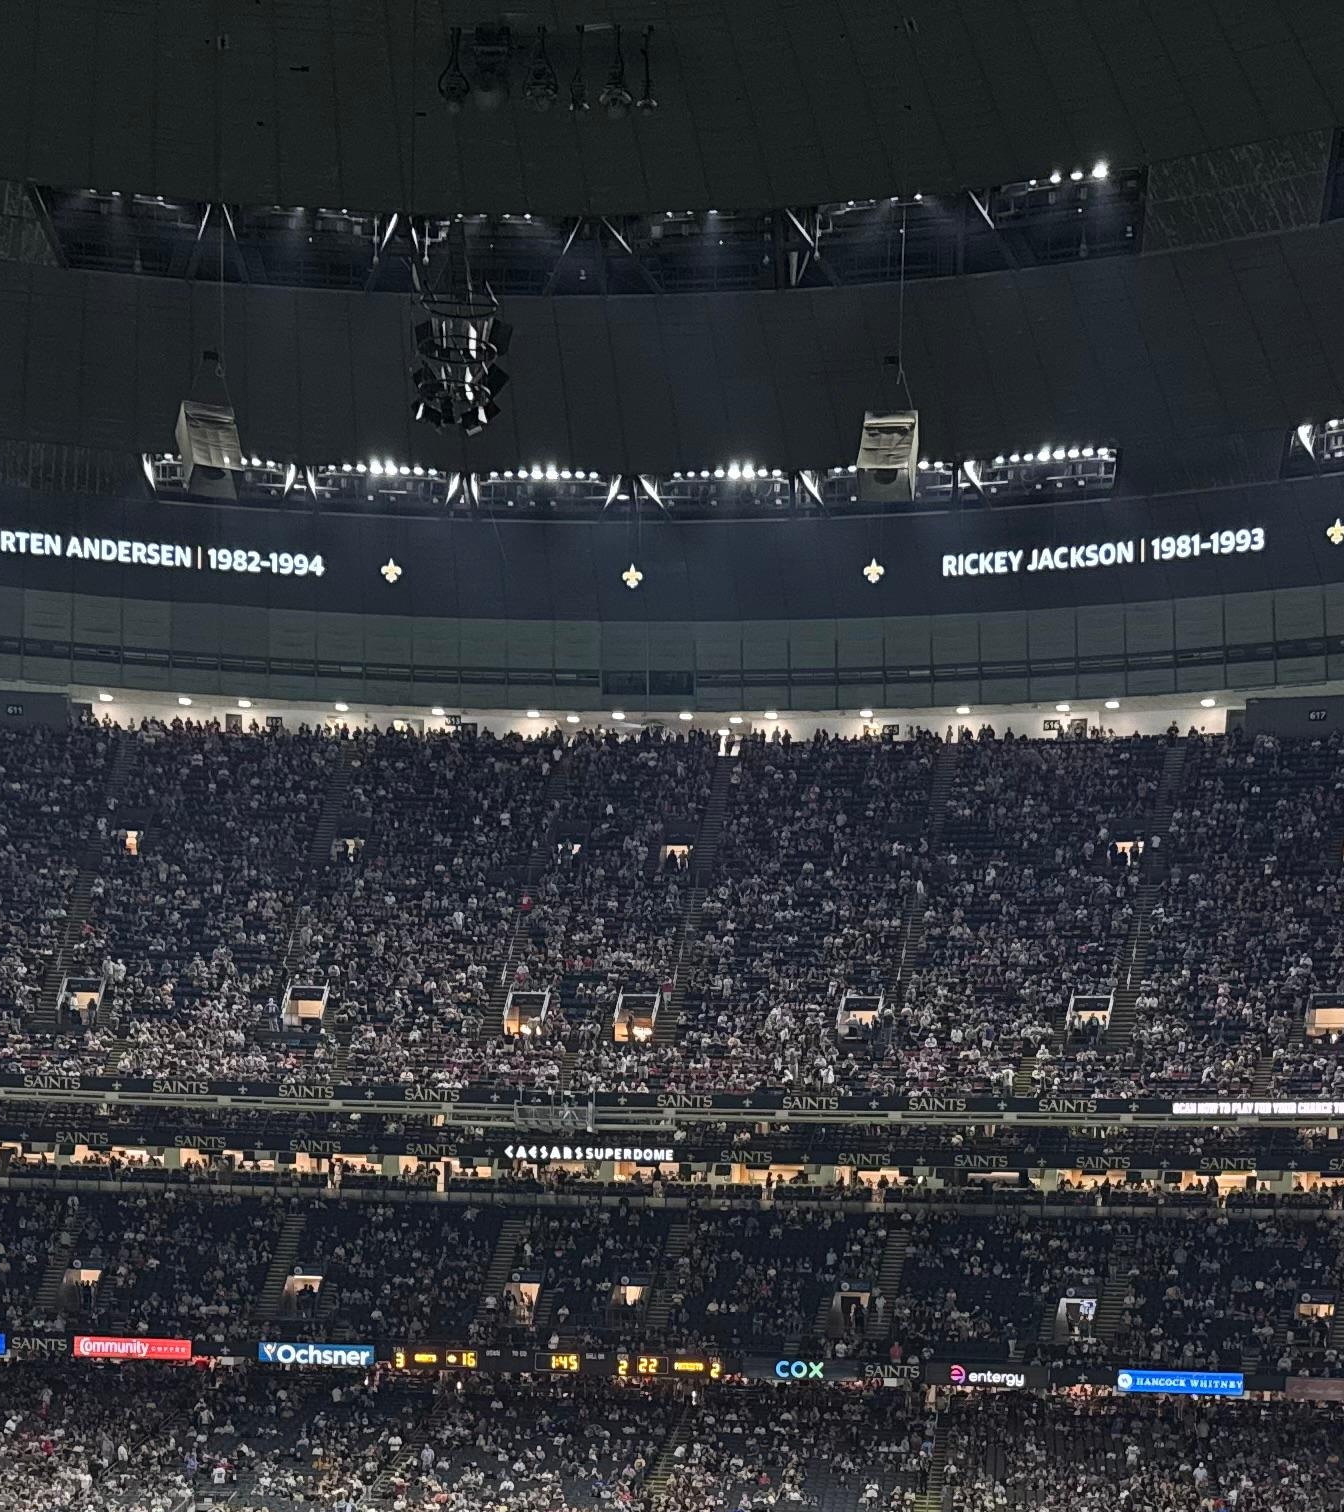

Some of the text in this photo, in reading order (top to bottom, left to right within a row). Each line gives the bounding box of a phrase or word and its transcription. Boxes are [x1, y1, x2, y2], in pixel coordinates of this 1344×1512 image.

[64, 536, 193, 568] ANDERSEN
[207, 547, 325, 577] 1982-1994
[941, 527, 1268, 578] RICKEY JACKSON 1981-1993
[1309, 711, 1325, 720] 617
[24, 1076, 80, 1090] SAINTS
[278, 1085, 334, 1099] SAINTS
[657, 1094, 712, 1109] SAINTS
[908, 1096, 966, 1111] SAINTS
[585, 1145, 673, 1161] SUPERDOME
[12, 1336, 68, 1352] SAINTS
[79, 1338, 149, 1357] Community
[276, 1344, 370, 1366] Ochsner
[395, 1352, 405, 1368] 3
[461, 1352, 476, 1368] 16
[550, 1355, 578, 1371] 1:45
[618, 1360, 628, 1375] 2
[639, 1358, 657, 1373] 22
[710, 1363, 721, 1378] 2
[775, 1360, 824, 1379] COX
[864, 1365, 920, 1379] SAINTS
[968, 1371, 1025, 1387] entergy
[1136, 1377, 1243, 1390] HANCOCK WHITNEY
